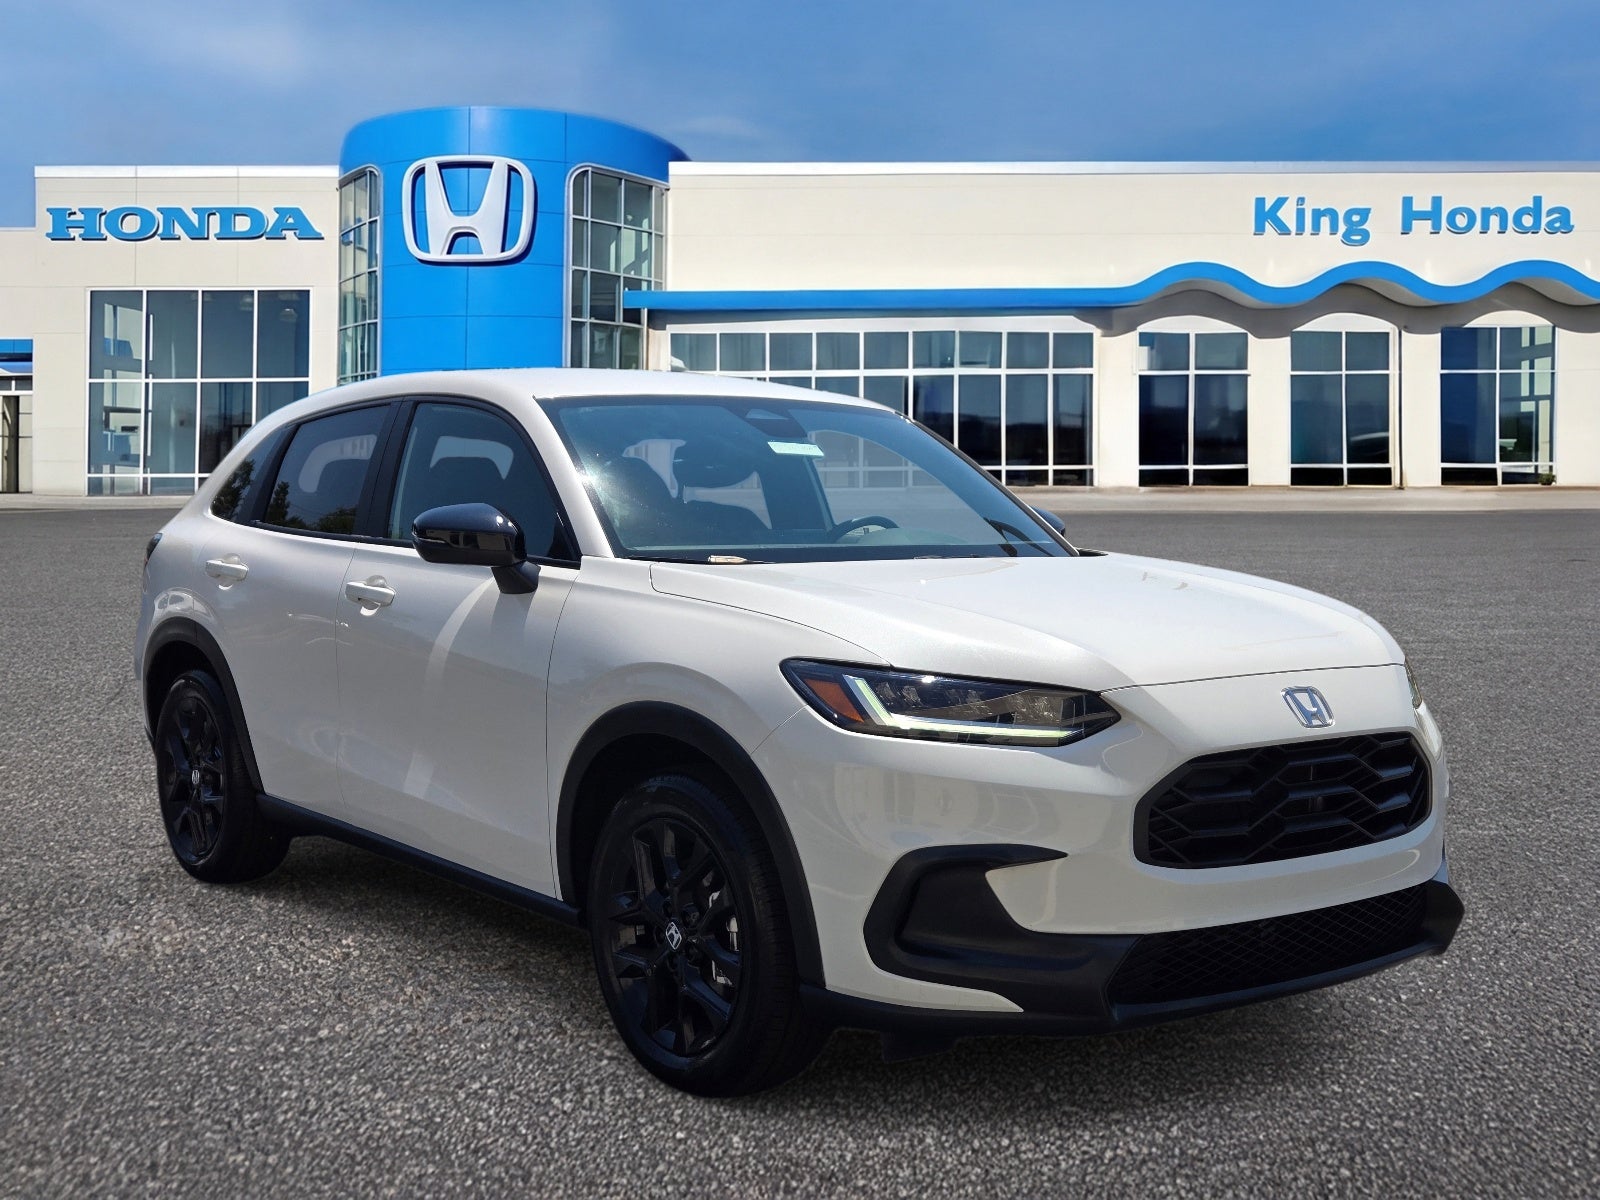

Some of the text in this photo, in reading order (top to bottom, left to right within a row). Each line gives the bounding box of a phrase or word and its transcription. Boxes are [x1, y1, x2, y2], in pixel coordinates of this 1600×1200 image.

[46, 206, 324, 241] HONDA
[1253, 195, 1575, 246] King Honda
